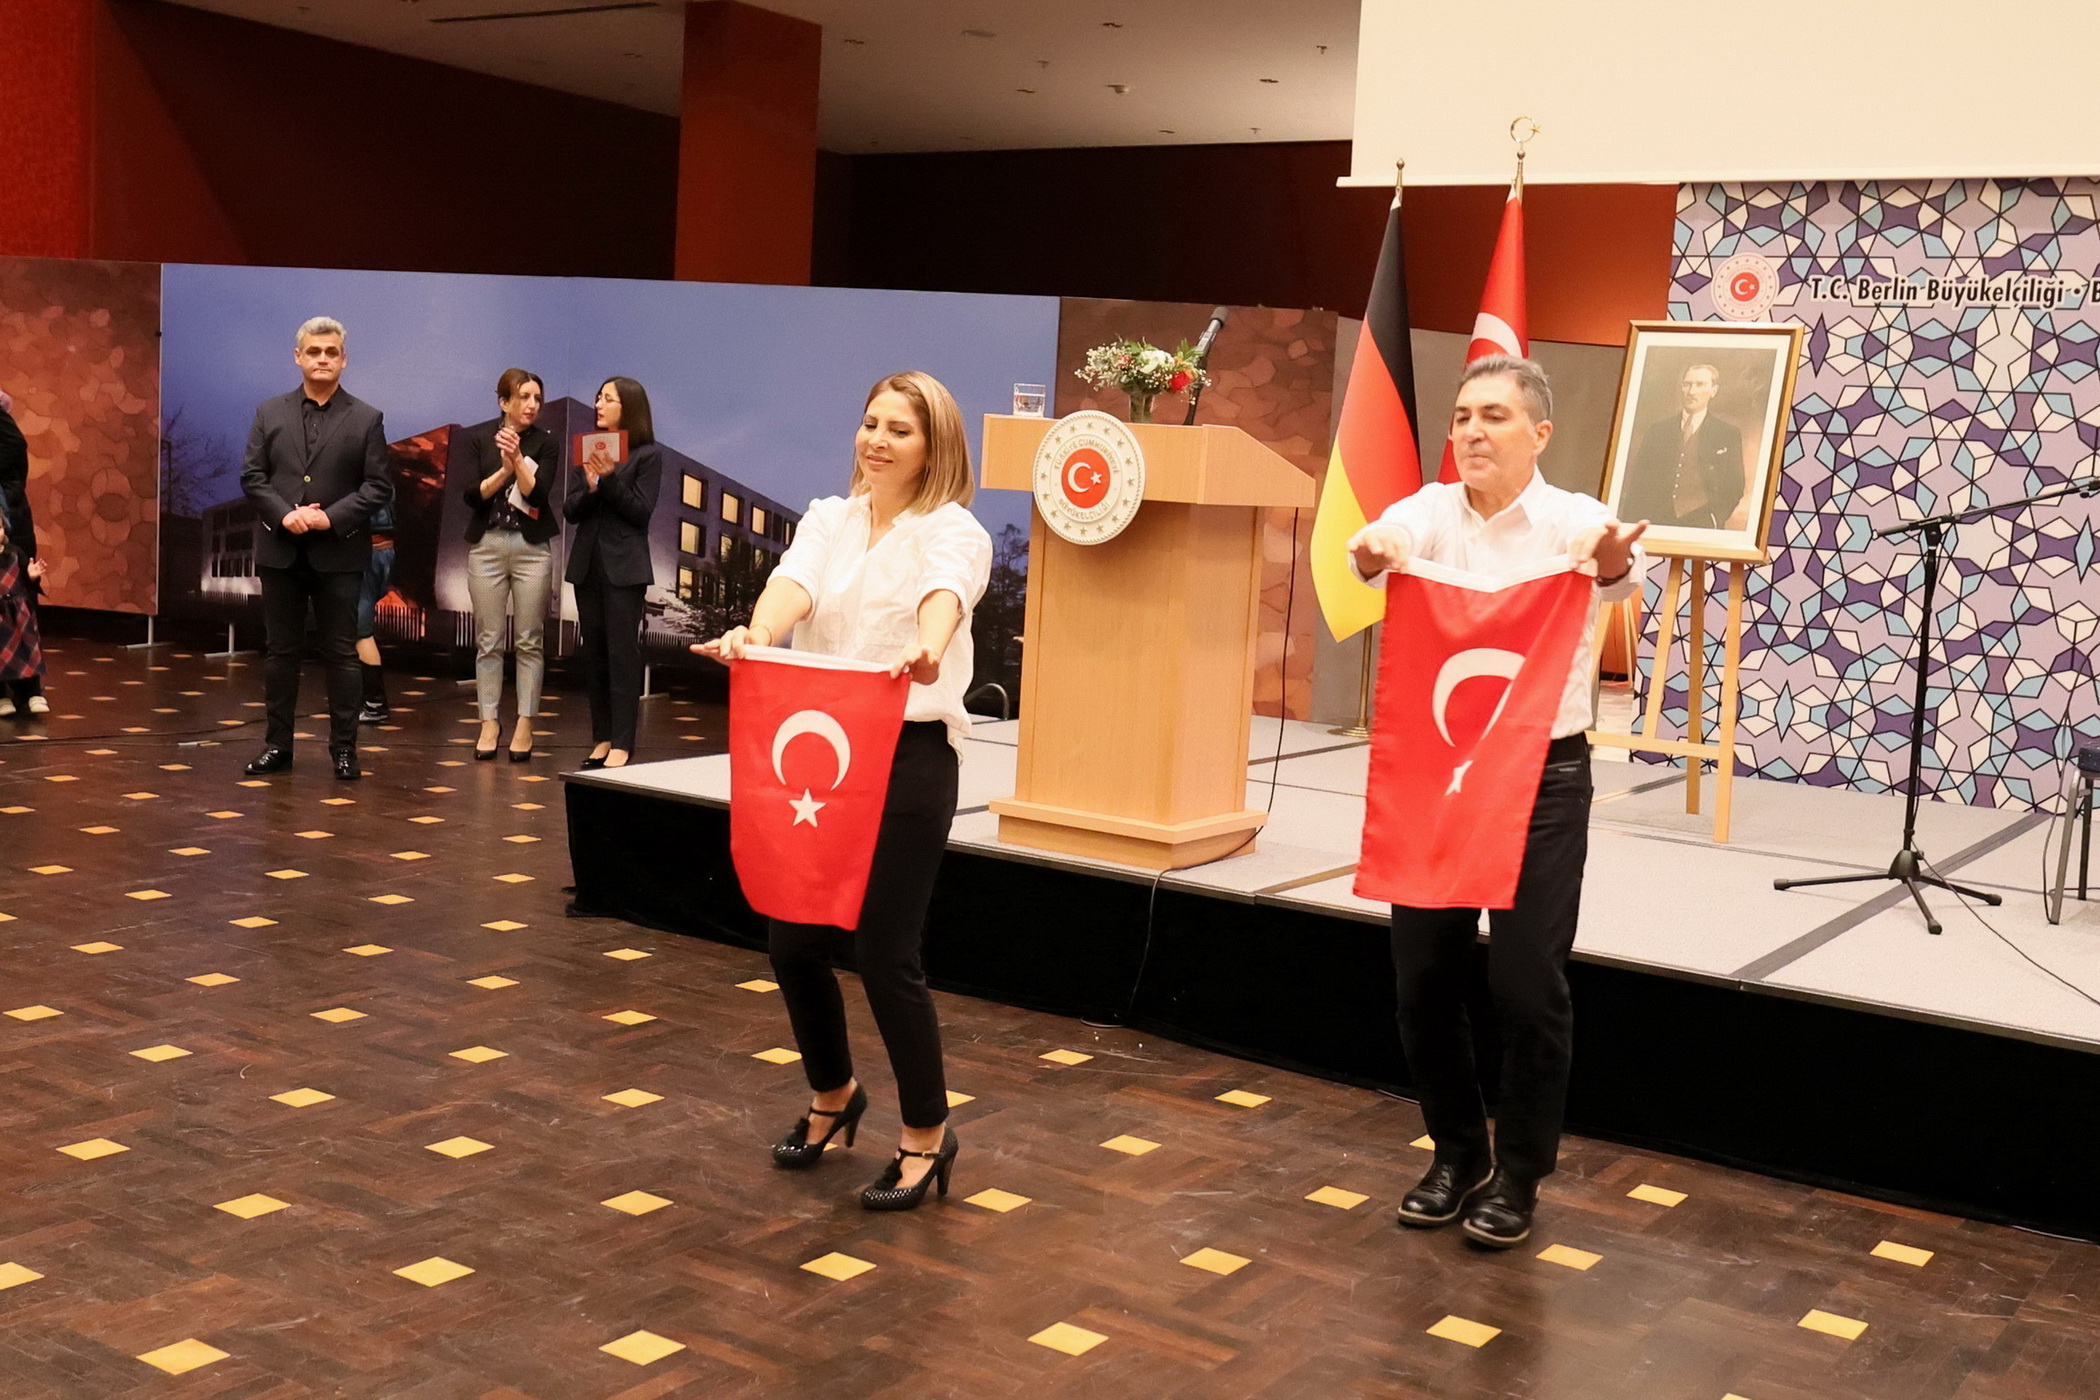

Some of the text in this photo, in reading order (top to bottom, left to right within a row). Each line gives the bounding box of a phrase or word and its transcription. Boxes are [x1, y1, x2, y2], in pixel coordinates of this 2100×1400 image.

[1811, 278, 1848, 300] T.C.
[1858, 276, 1918, 300] Berlin
[1927, 277, 2064, 309] Büyükelçiliği
